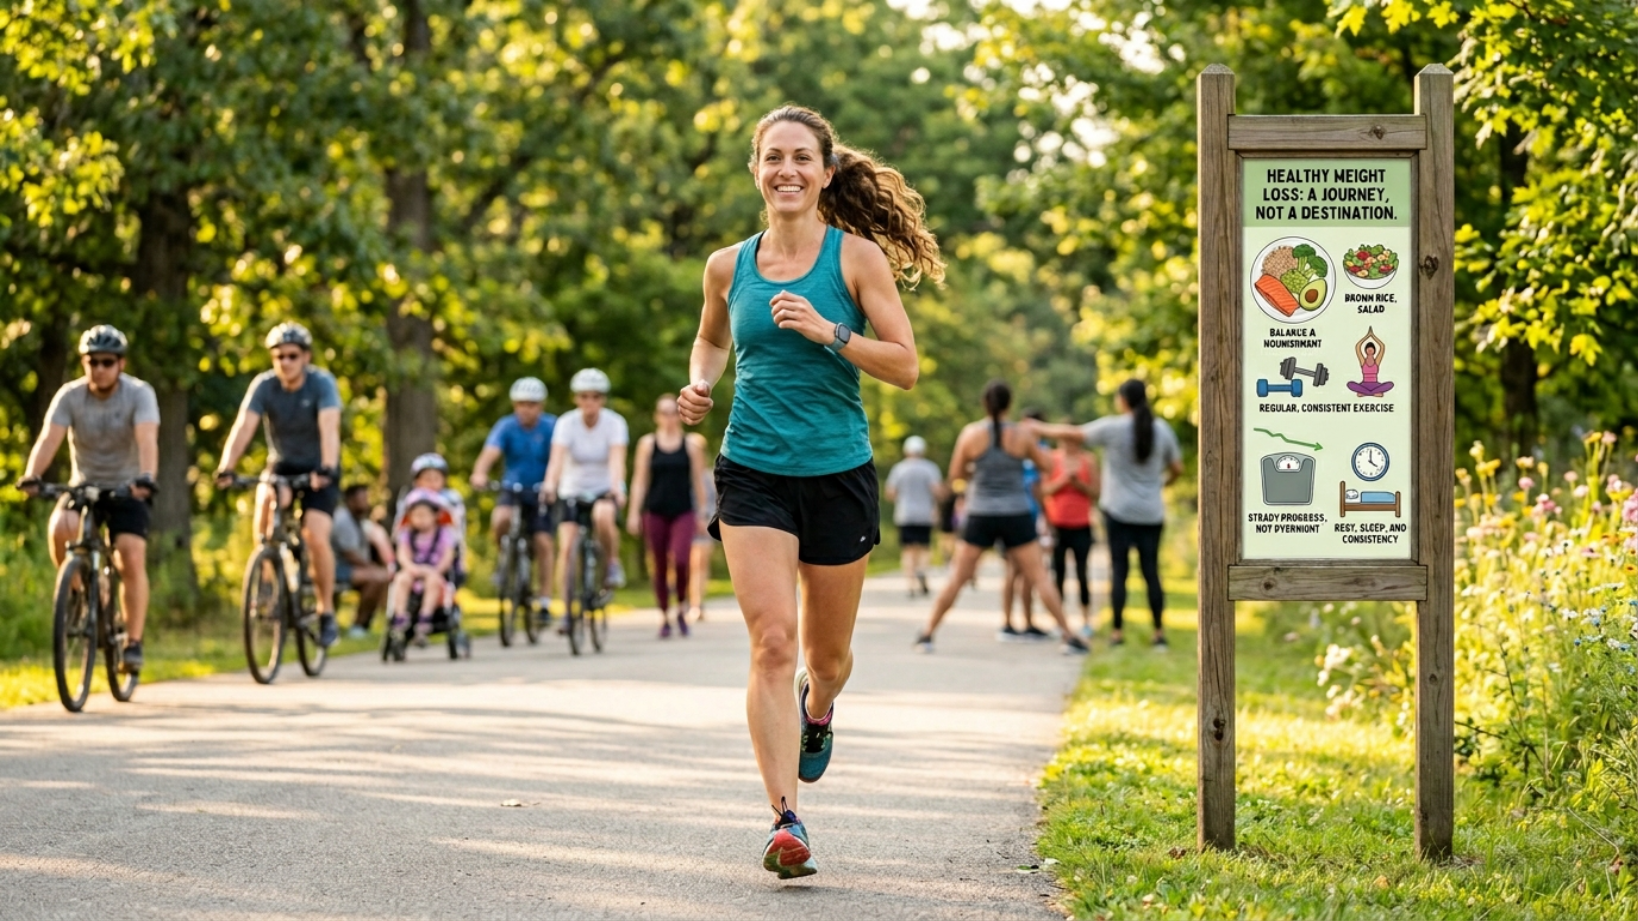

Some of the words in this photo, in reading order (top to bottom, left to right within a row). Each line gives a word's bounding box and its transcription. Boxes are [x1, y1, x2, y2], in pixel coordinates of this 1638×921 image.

[1267, 169, 1330, 183] HEALTHY
[1263, 187, 1303, 201] LOSS:
[1307, 187, 1317, 201] A
[1321, 187, 1389, 203] JOURNEY,
[1256, 206, 1284, 220] NOT
[1288, 206, 1297, 220] A
[1301, 206, 1397, 220] DESTINATION.
[1357, 305, 1385, 314] SALAD
[1309, 328, 1316, 337] A
[1259, 403, 1299, 413] REGULAR,
[1301, 403, 1351, 412] CONSISTENT
[1353, 403, 1394, 412] EXERCISE
[1342, 535, 1398, 544] CONSISTENCY
